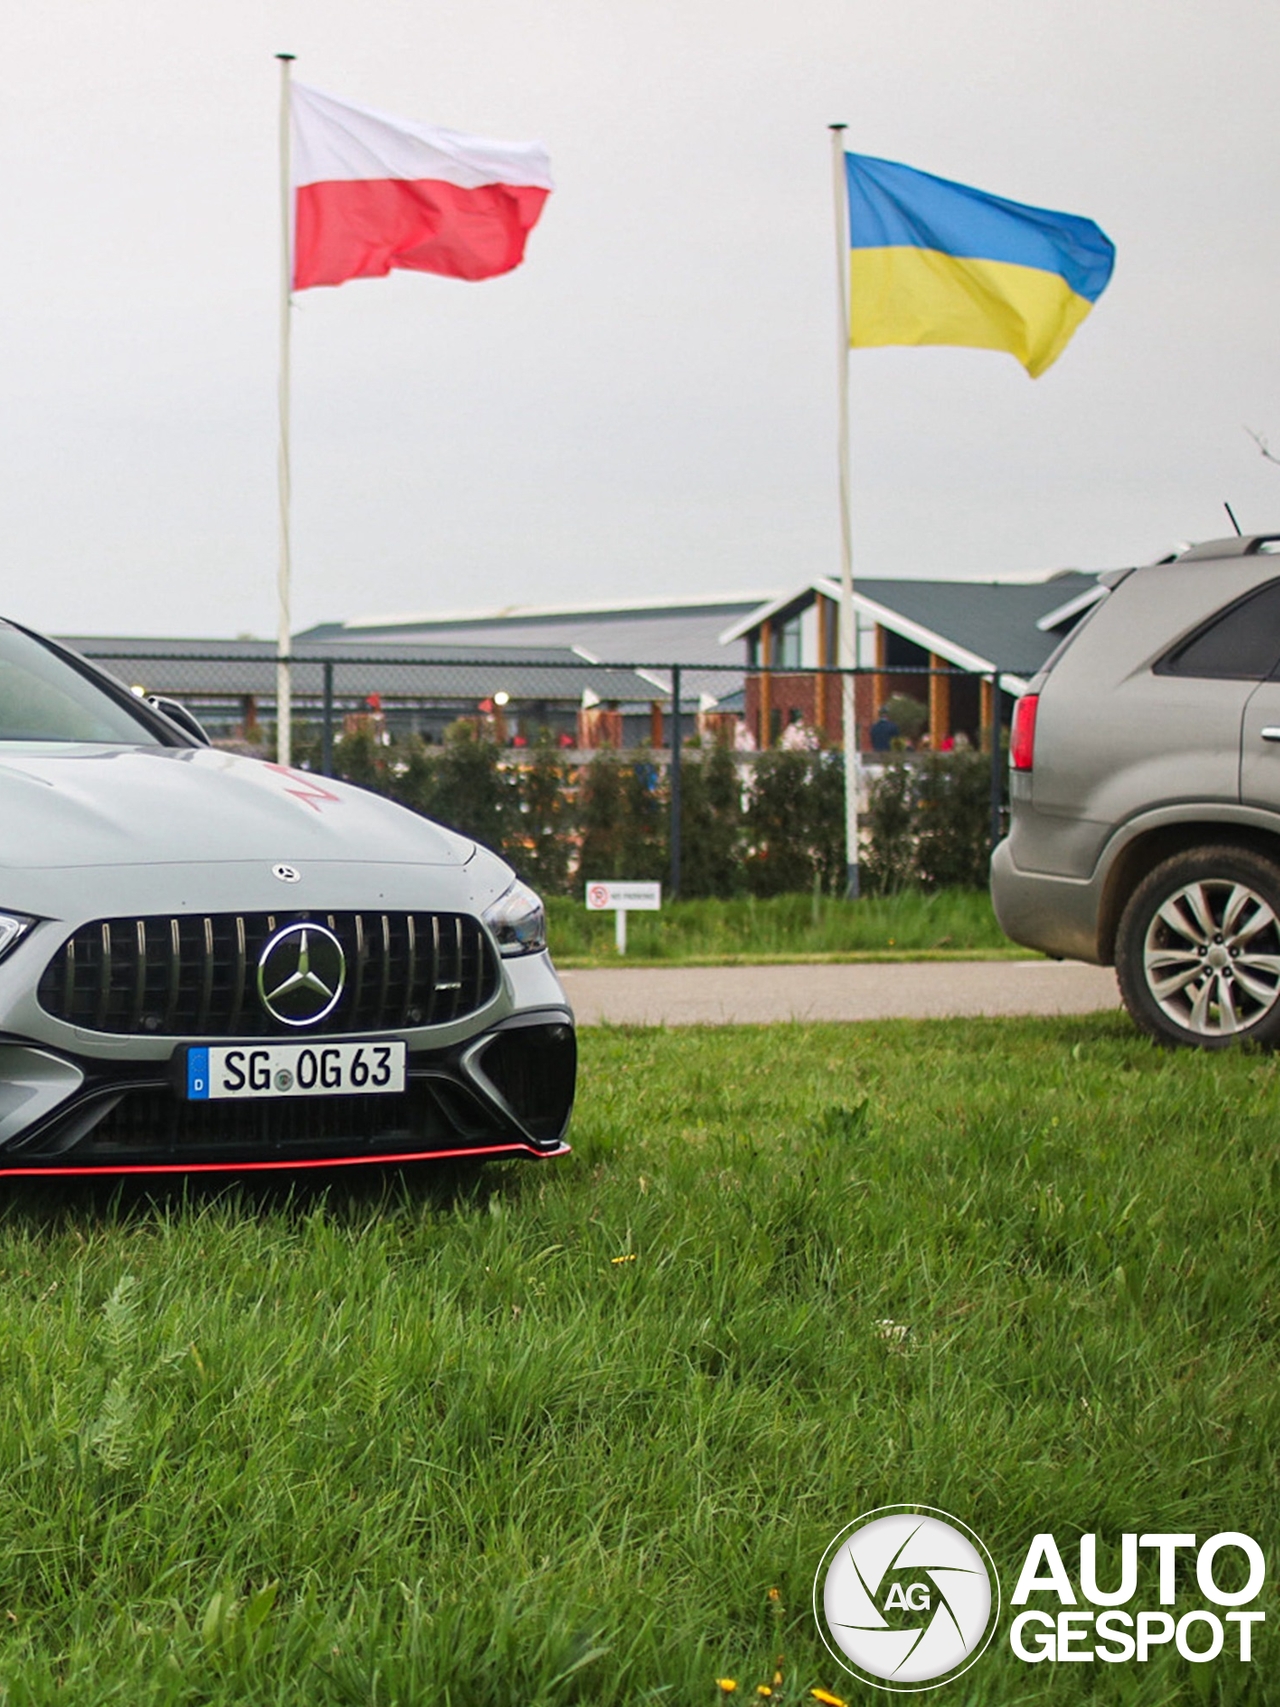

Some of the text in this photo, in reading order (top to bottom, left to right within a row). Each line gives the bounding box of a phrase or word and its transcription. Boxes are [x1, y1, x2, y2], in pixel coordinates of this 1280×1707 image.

[223, 1047, 391, 1091] SG OG 63
[194, 1079, 203, 1091] D
